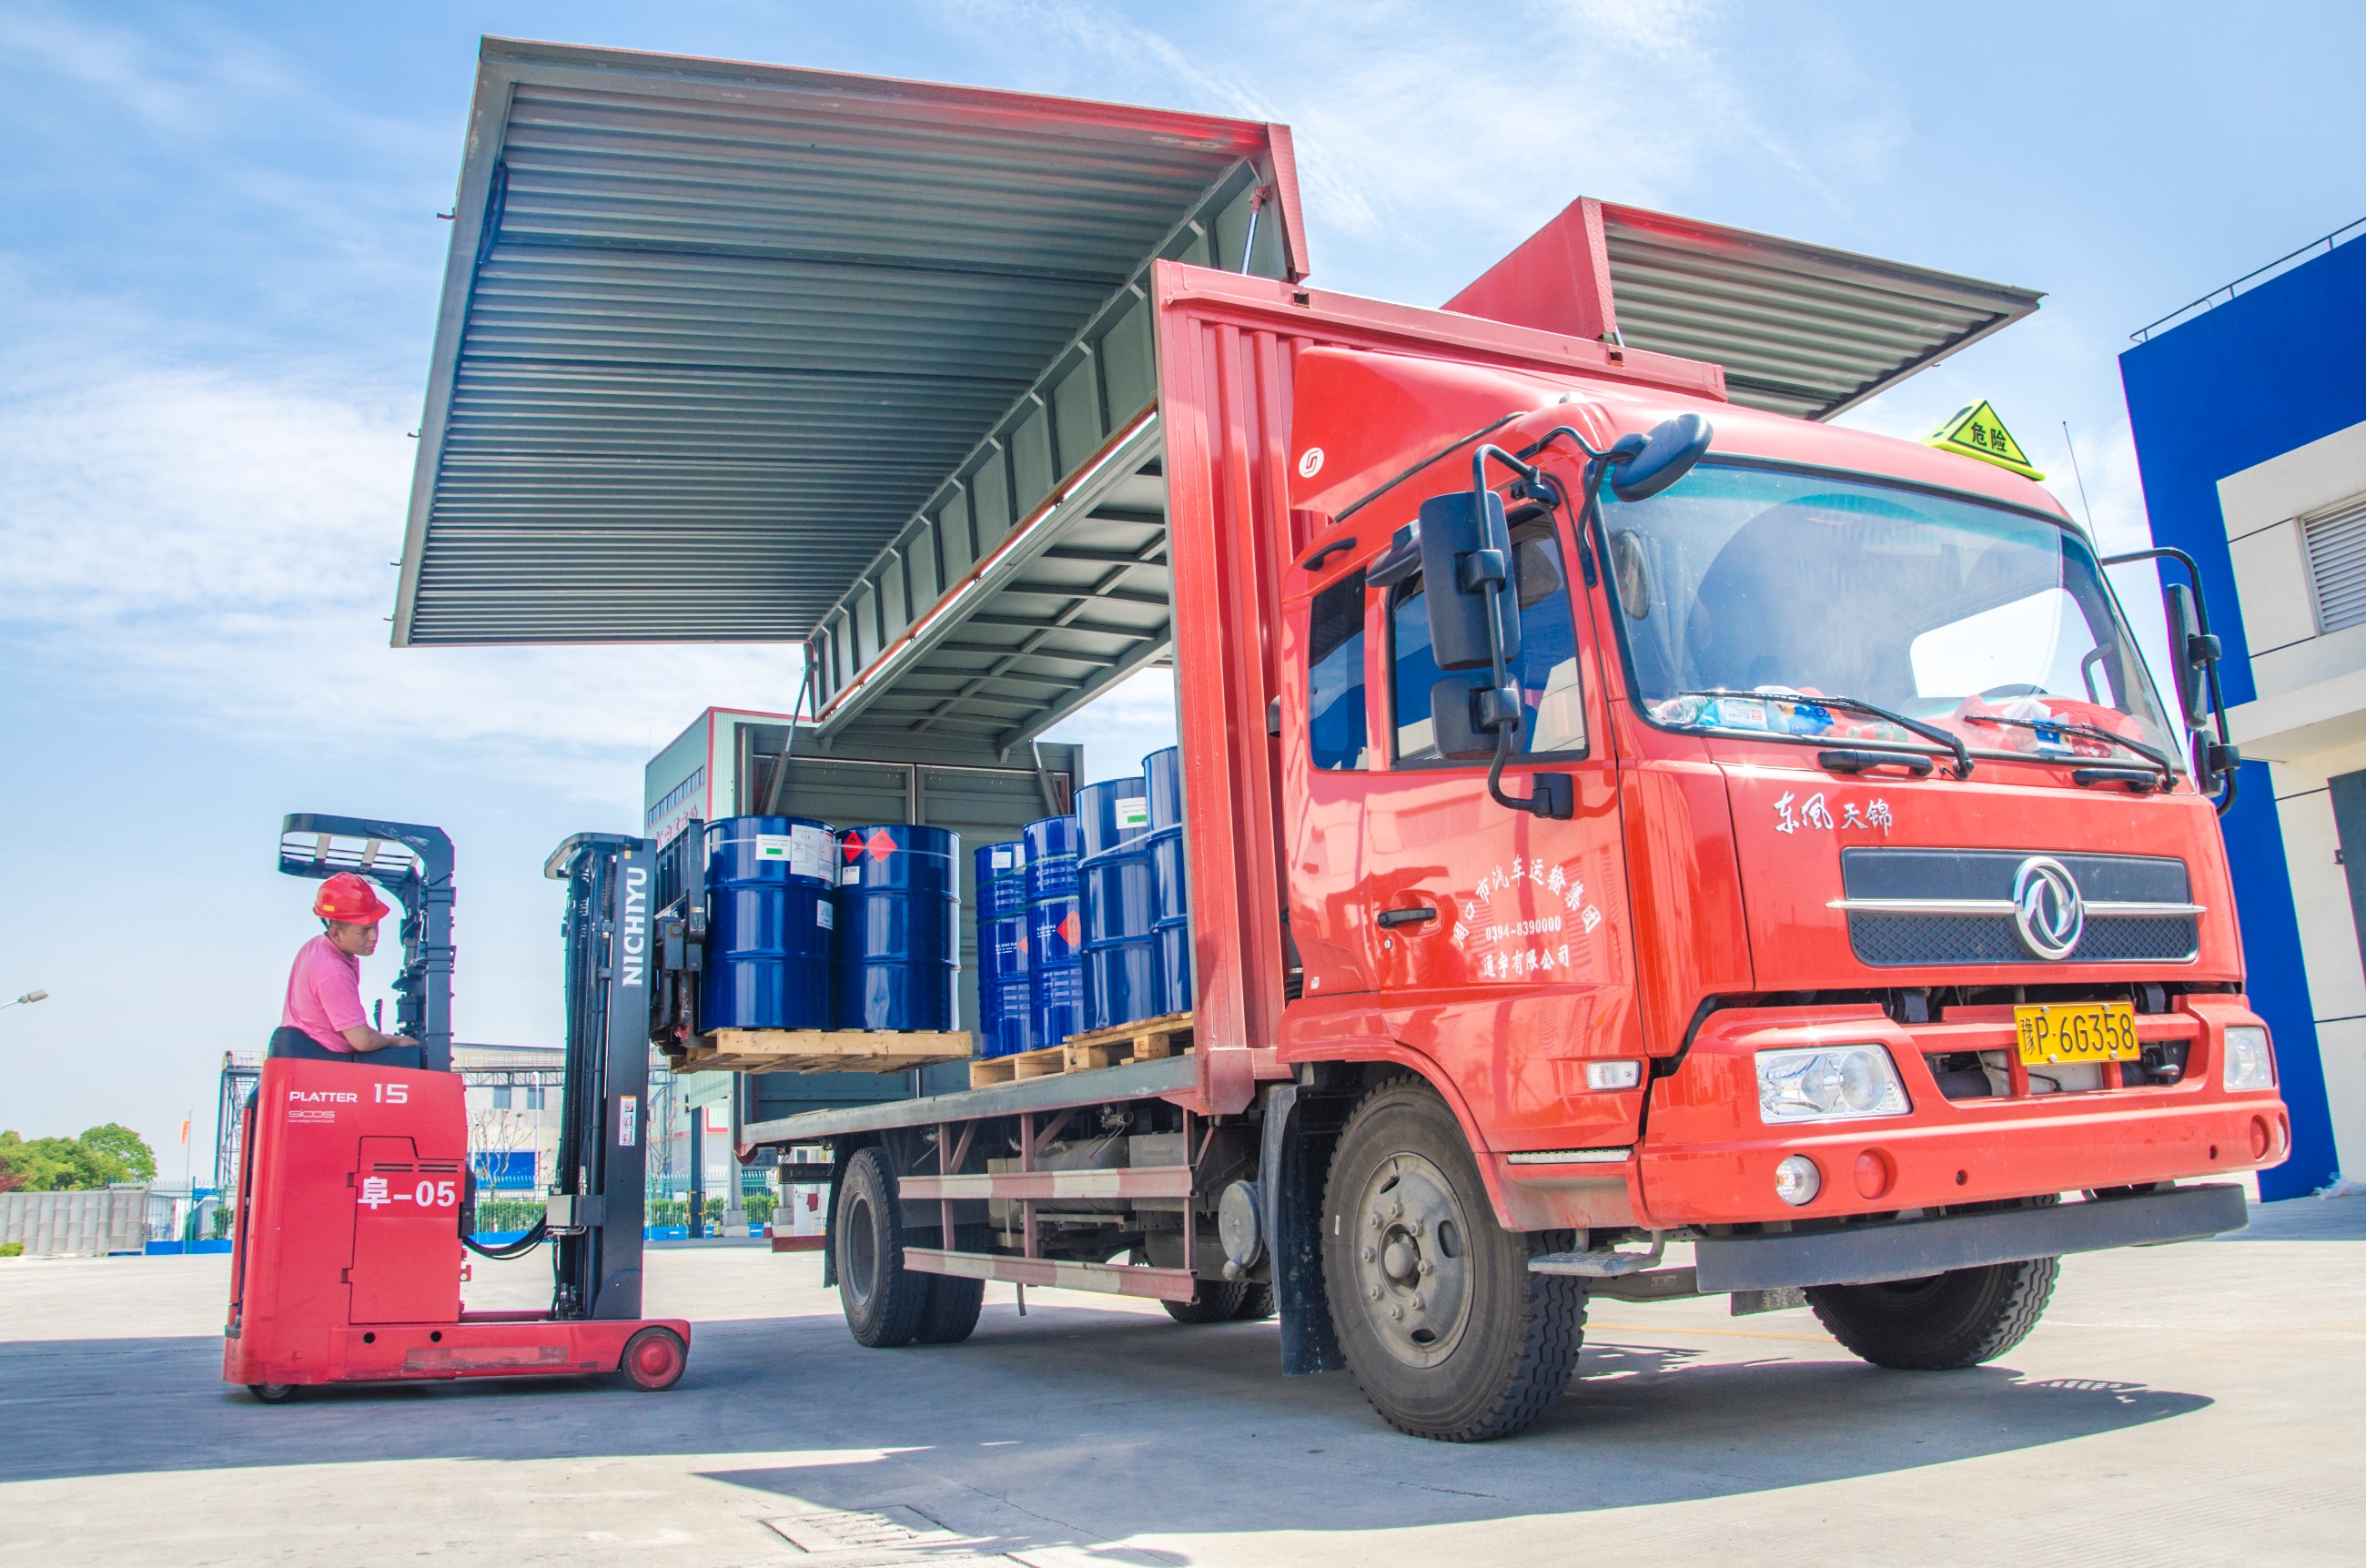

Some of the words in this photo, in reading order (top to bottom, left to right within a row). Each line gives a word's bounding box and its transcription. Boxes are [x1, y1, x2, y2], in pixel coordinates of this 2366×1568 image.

[1970, 421, 2007, 452] 危险
[1453, 854, 1602, 949] 周口市汽车运输集团
[622, 867, 647, 986] NICHIYU
[1485, 916, 1562, 943] 0394-8390000
[1483, 944, 1570, 979] 通宇有限公司
[288, 1091, 358, 1103] PLATTER
[374, 1083, 409, 1104] 15
[357, 1176, 456, 1209] 阜-05
